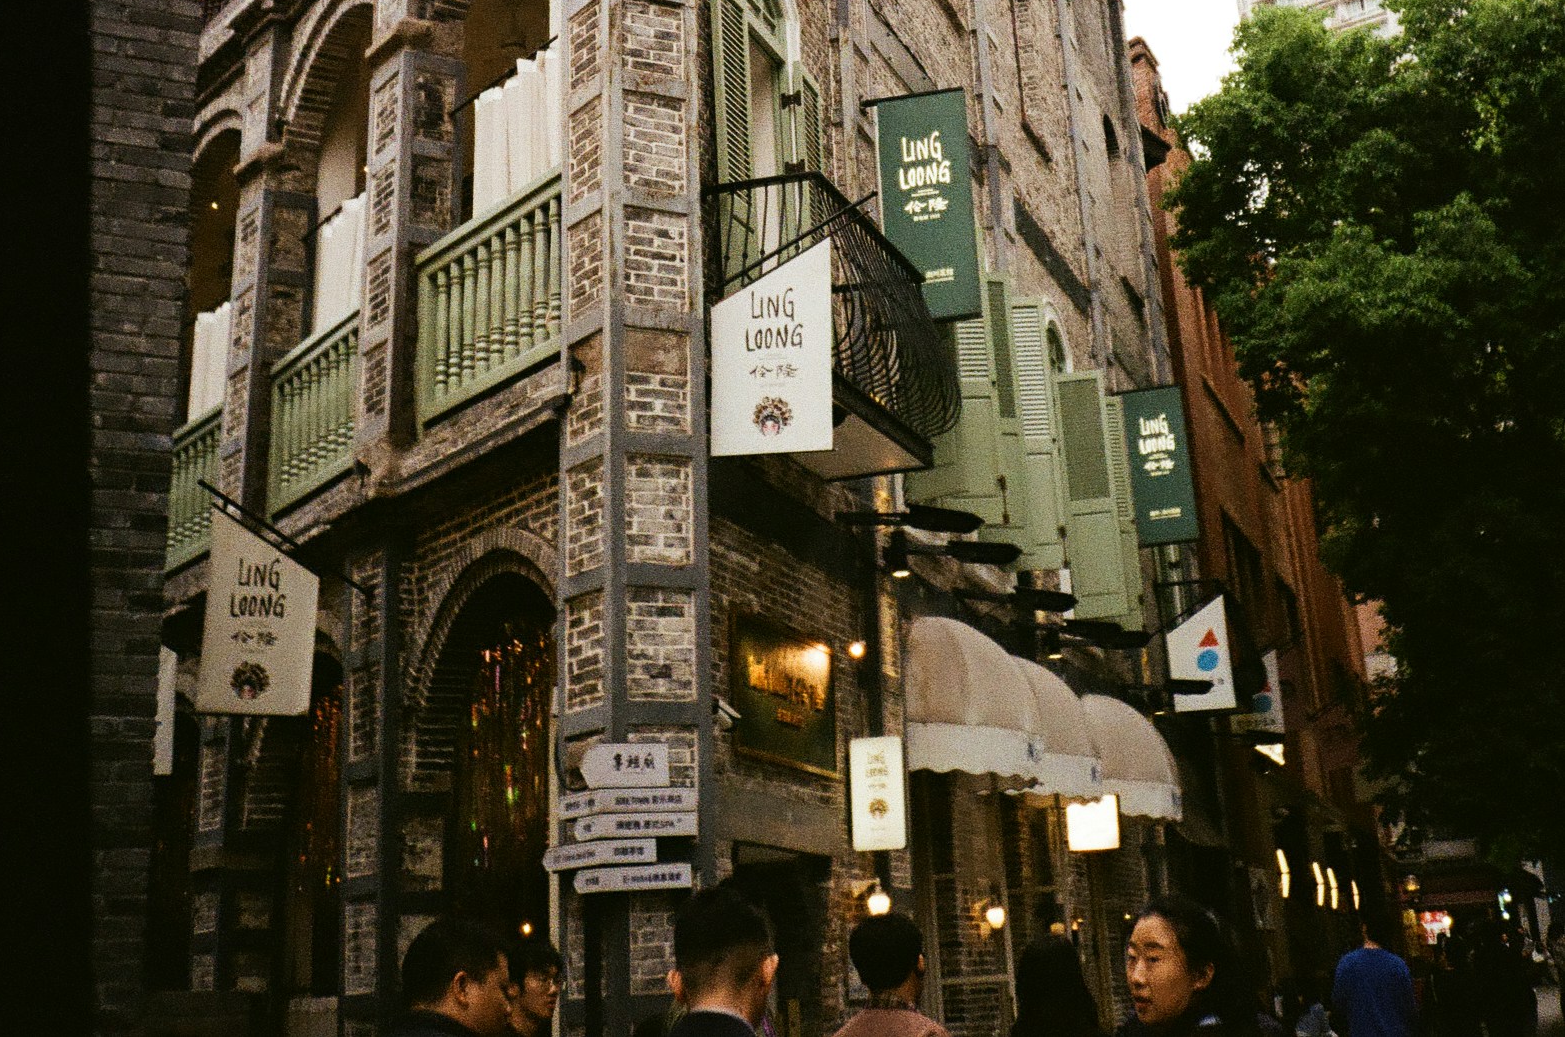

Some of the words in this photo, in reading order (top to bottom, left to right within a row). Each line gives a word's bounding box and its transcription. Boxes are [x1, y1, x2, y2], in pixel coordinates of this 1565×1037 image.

[901, 131, 943, 162] LING
[899, 161, 951, 190] LOONG
[751, 287, 795, 321] LING
[745, 323, 804, 352] LOONG
[1139, 413, 1169, 436] LING
[238, 558, 281, 592] LING
[230, 594, 287, 619] LOONG
